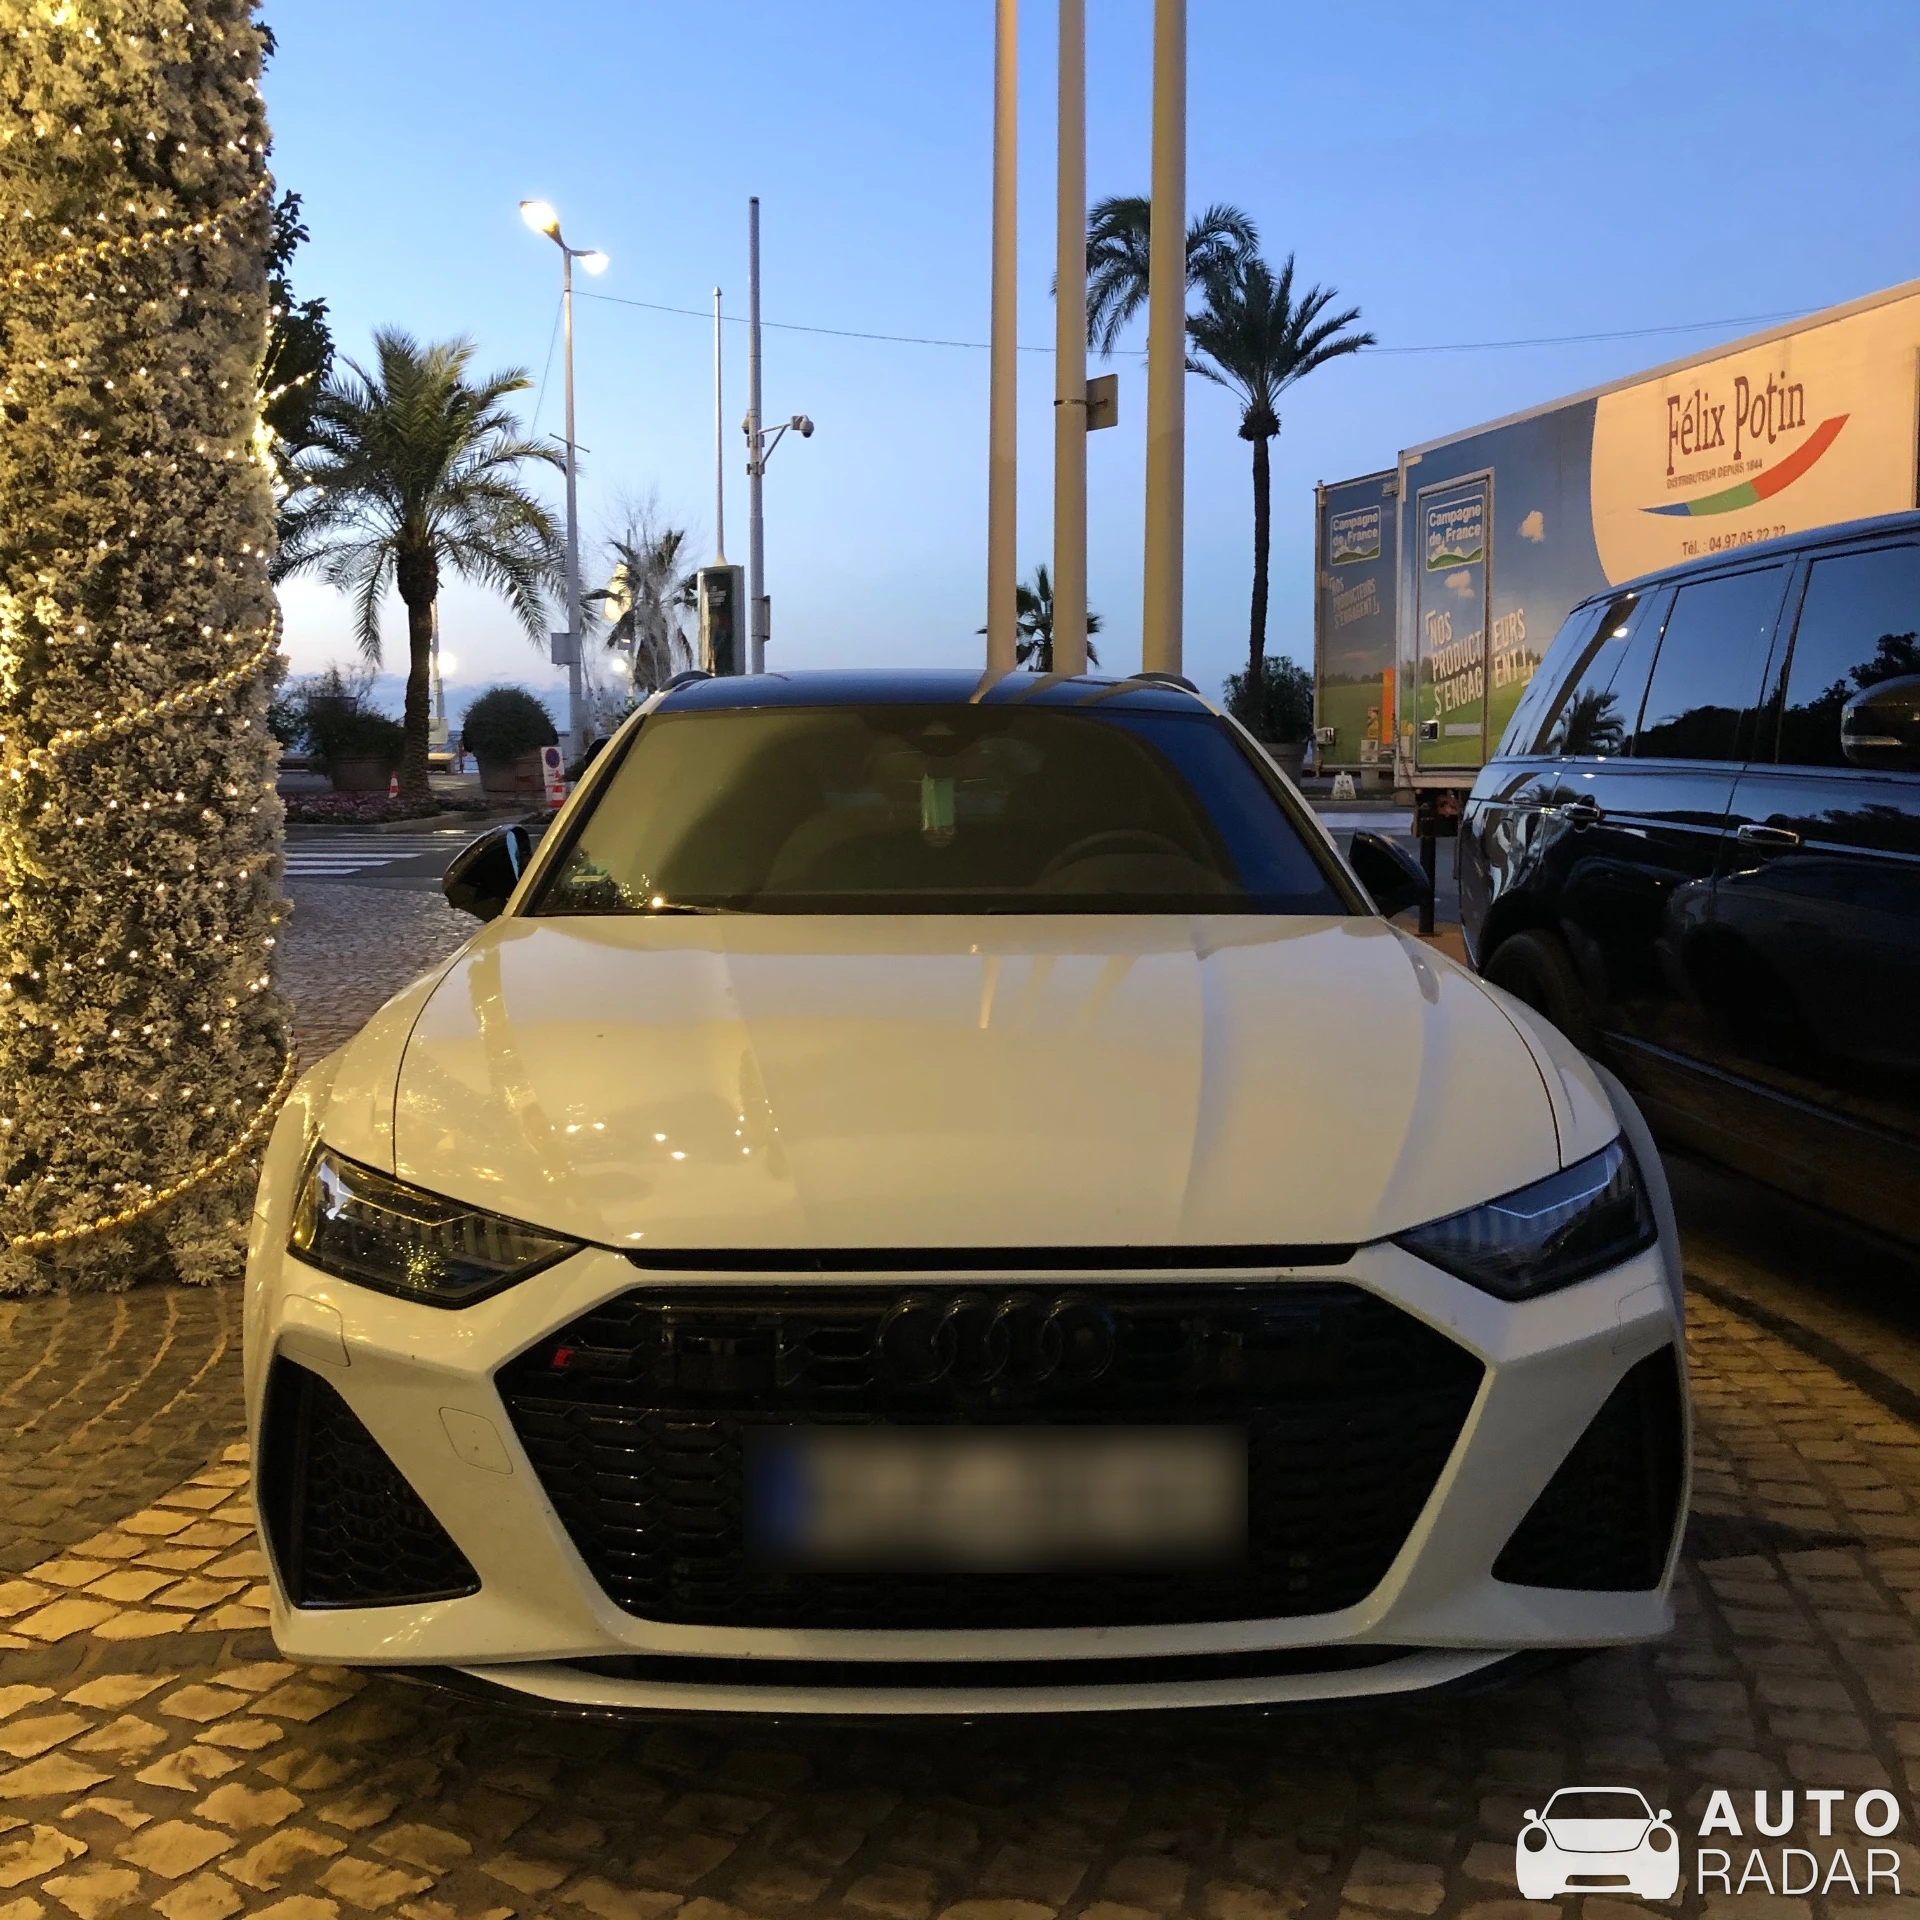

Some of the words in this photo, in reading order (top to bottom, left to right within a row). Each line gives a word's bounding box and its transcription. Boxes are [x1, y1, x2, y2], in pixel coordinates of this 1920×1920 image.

[1667, 389, 1725, 476] Félix
[1733, 371, 1806, 460] Potin
[1667, 469, 1716, 489] DISTRIBUTEUR
[1718, 462, 1744, 479] DEPUIS
[1333, 513, 1379, 532] Campagne
[1429, 504, 1481, 527] Campagne
[1333, 534, 1344, 547] de
[1347, 528, 1378, 543] France
[1429, 532, 1441, 547] de
[1445, 523, 1481, 543] France
[1709, 525, 1786, 551] 04.97.05.2222
[1430, 611, 1452, 648] NOS
